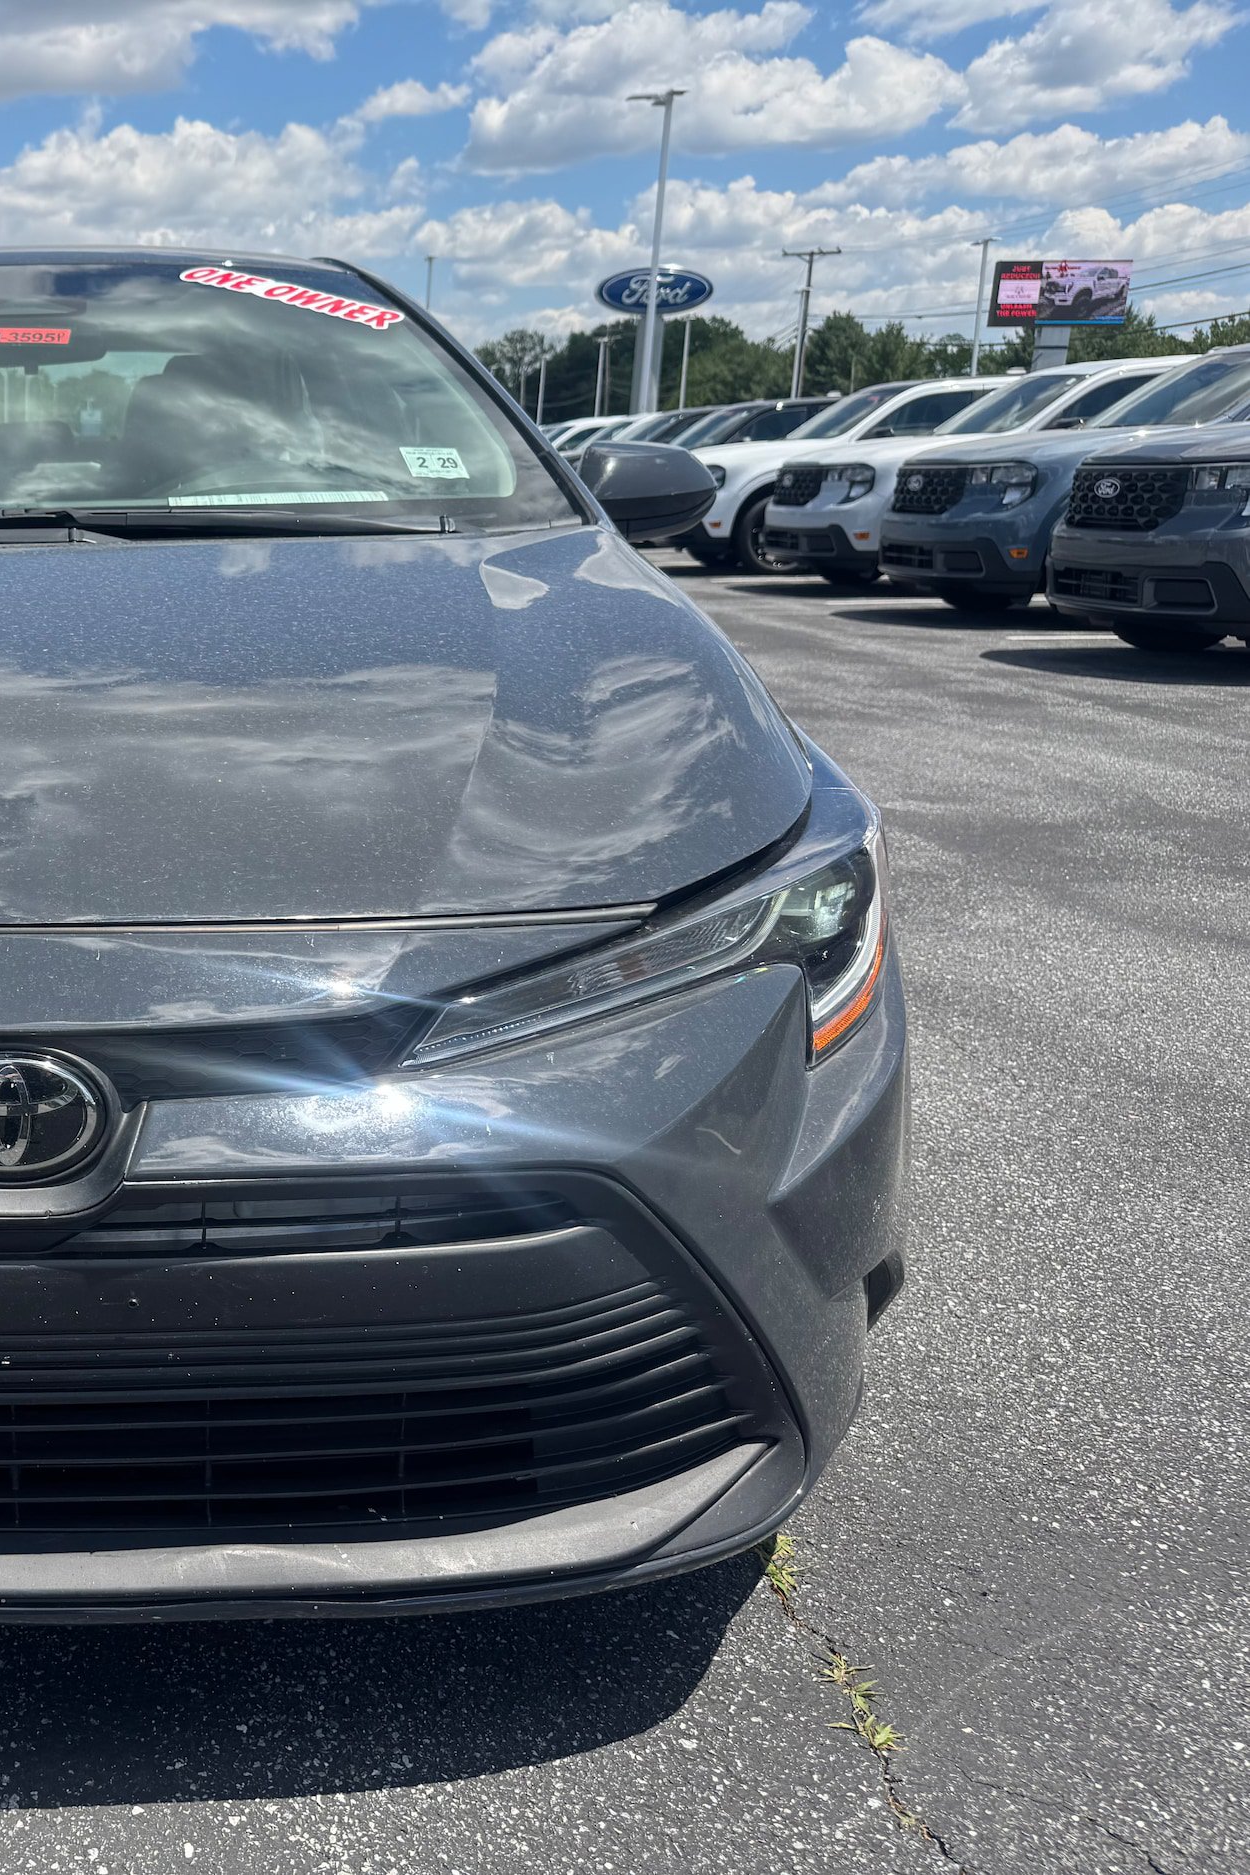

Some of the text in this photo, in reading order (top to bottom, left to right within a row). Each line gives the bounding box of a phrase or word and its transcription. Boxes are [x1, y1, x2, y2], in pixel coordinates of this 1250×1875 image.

[184, 267, 400, 328] ONE OWNER
[416, 456, 458, 469] 2 29
